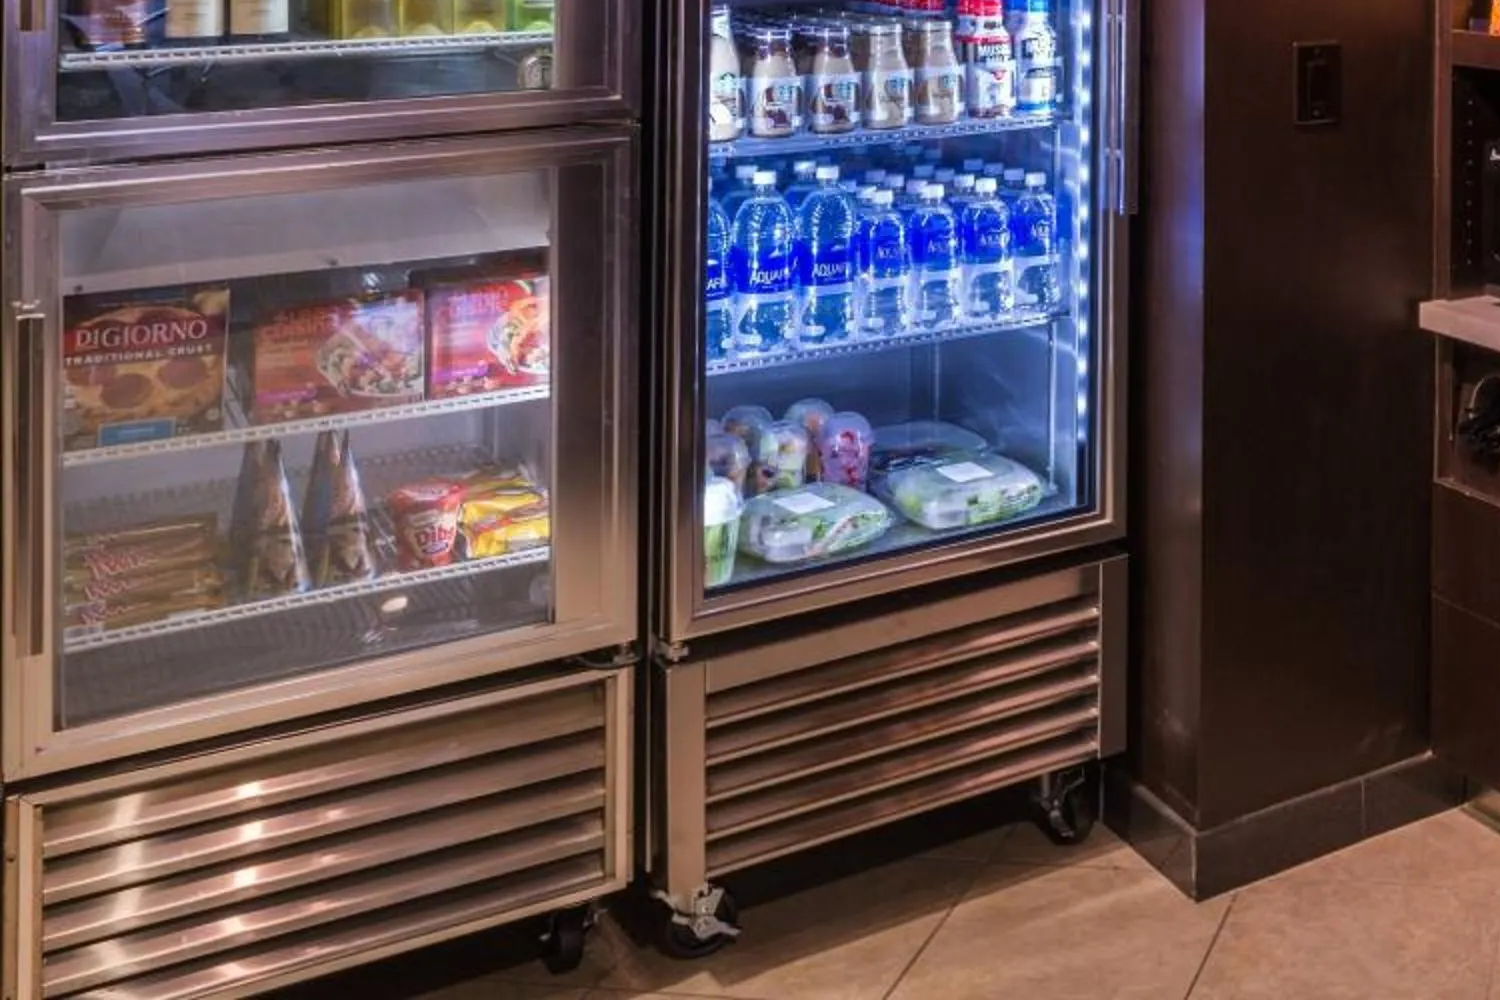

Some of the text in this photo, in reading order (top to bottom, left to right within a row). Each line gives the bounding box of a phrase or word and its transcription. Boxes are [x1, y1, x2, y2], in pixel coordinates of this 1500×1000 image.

[75, 319, 208, 349] DIGIORNO
[64, 343, 213, 367] TRADITIONAL CRUST
